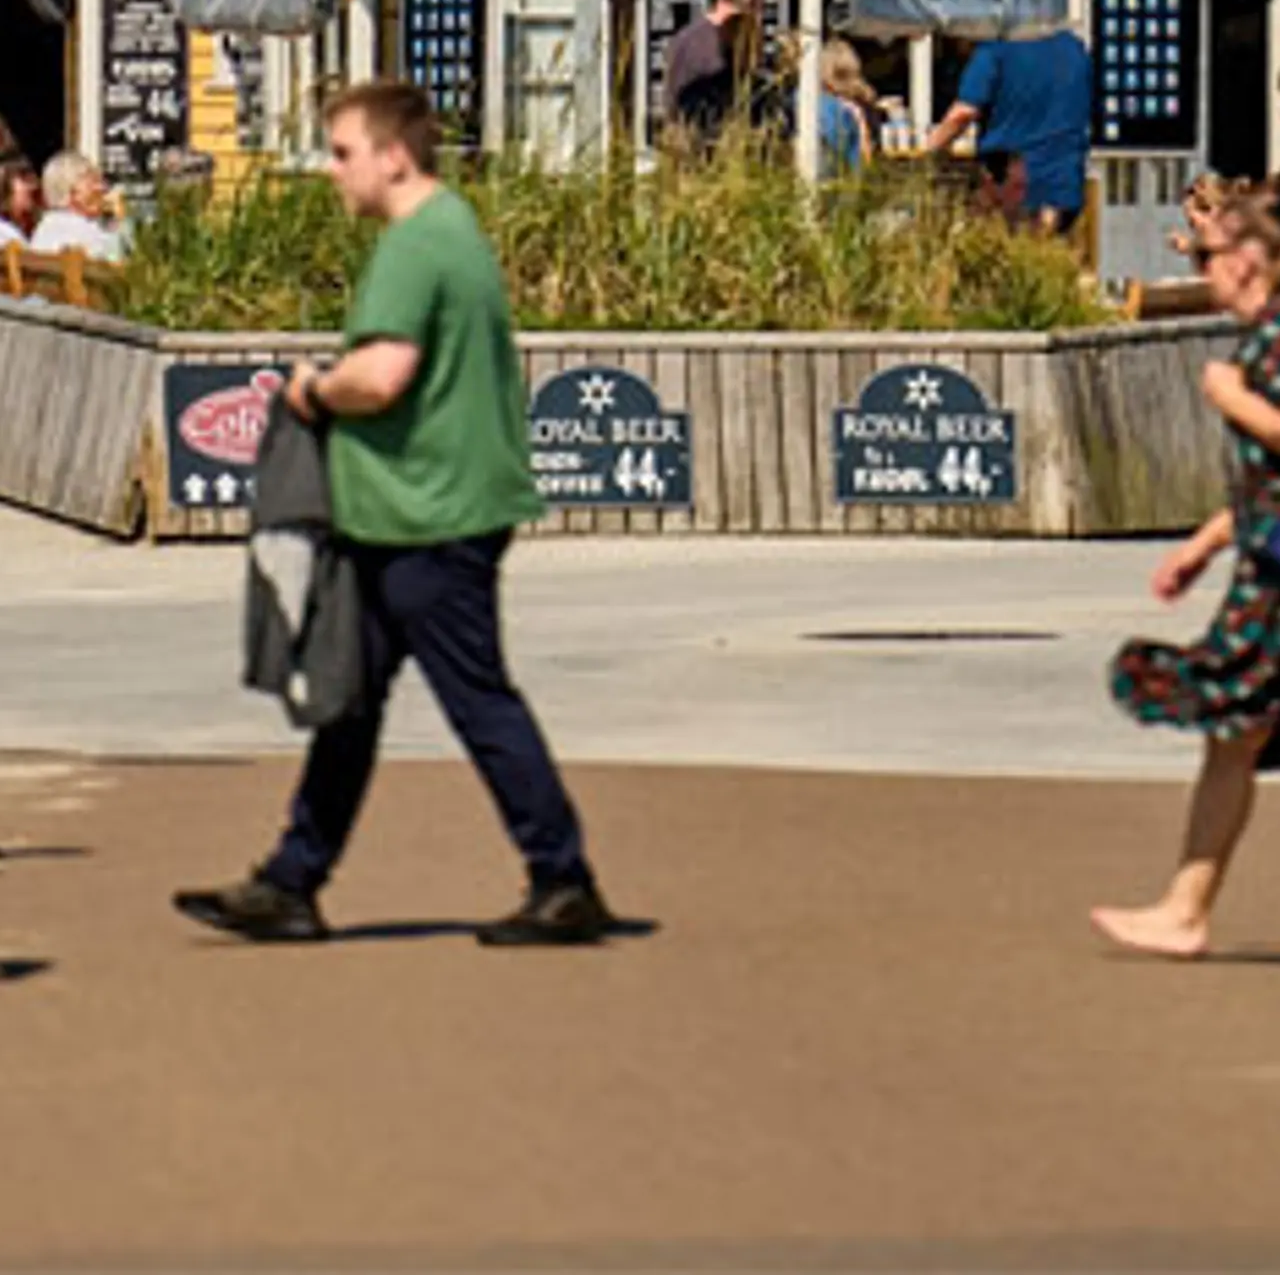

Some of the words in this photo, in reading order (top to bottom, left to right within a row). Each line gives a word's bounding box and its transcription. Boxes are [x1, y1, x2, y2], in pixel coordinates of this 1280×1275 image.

[612, 417, 683, 444] BEER
[842, 414, 931, 444] ROYAL
[936, 414, 1010, 445] BEER
